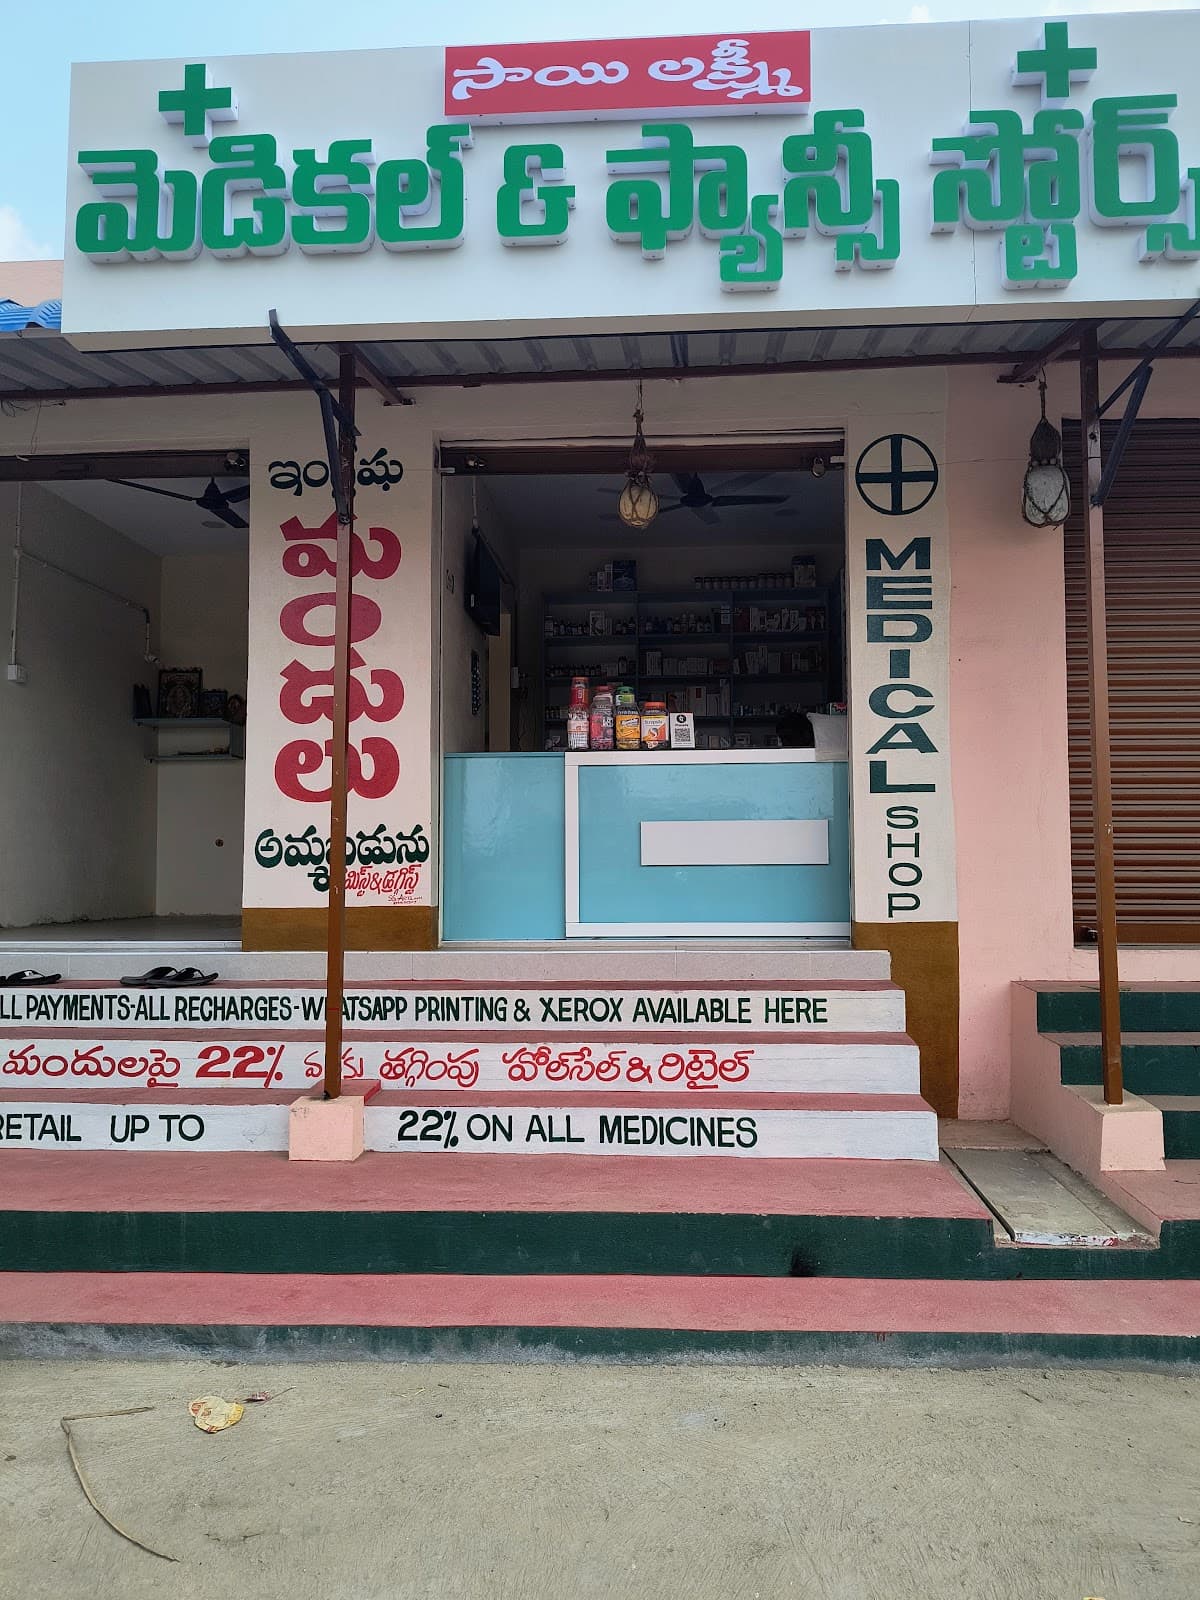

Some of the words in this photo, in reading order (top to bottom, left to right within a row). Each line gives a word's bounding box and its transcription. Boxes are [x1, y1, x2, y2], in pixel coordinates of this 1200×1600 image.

[452, 57, 630, 100] సాయి
[648, 38, 804, 99] లక్ష్మీ
[75, 123, 471, 253] మెడికల్
[497, 144, 575, 238] &
[606, 109, 901, 283] ఫ్యాన్సీ
[865, 537, 939, 794] MEDICAL
[886, 805, 923, 918] SHOP
[415, 995, 507, 1022] PRINTING
[513, 997, 531, 1021] &
[541, 997, 623, 1023] XEROX
[632, 997, 752, 1024] AVAILABLE
[764, 998, 828, 1024] HERE
[2, 1044, 181, 1087] మందులపై
[195, 1044, 285, 1088] 22%
[303, 1047, 364, 1079] వకు
[0, 1112, 82, 1142] ETAIL
[110, 1114, 150, 1143] UP
[158, 1114, 205, 1142] TO
[398, 1109, 459, 1149] 22%
[466, 1113, 513, 1142] ON
[525, 1114, 585, 1143] ALL
[599, 1115, 759, 1148] MEDICINES
